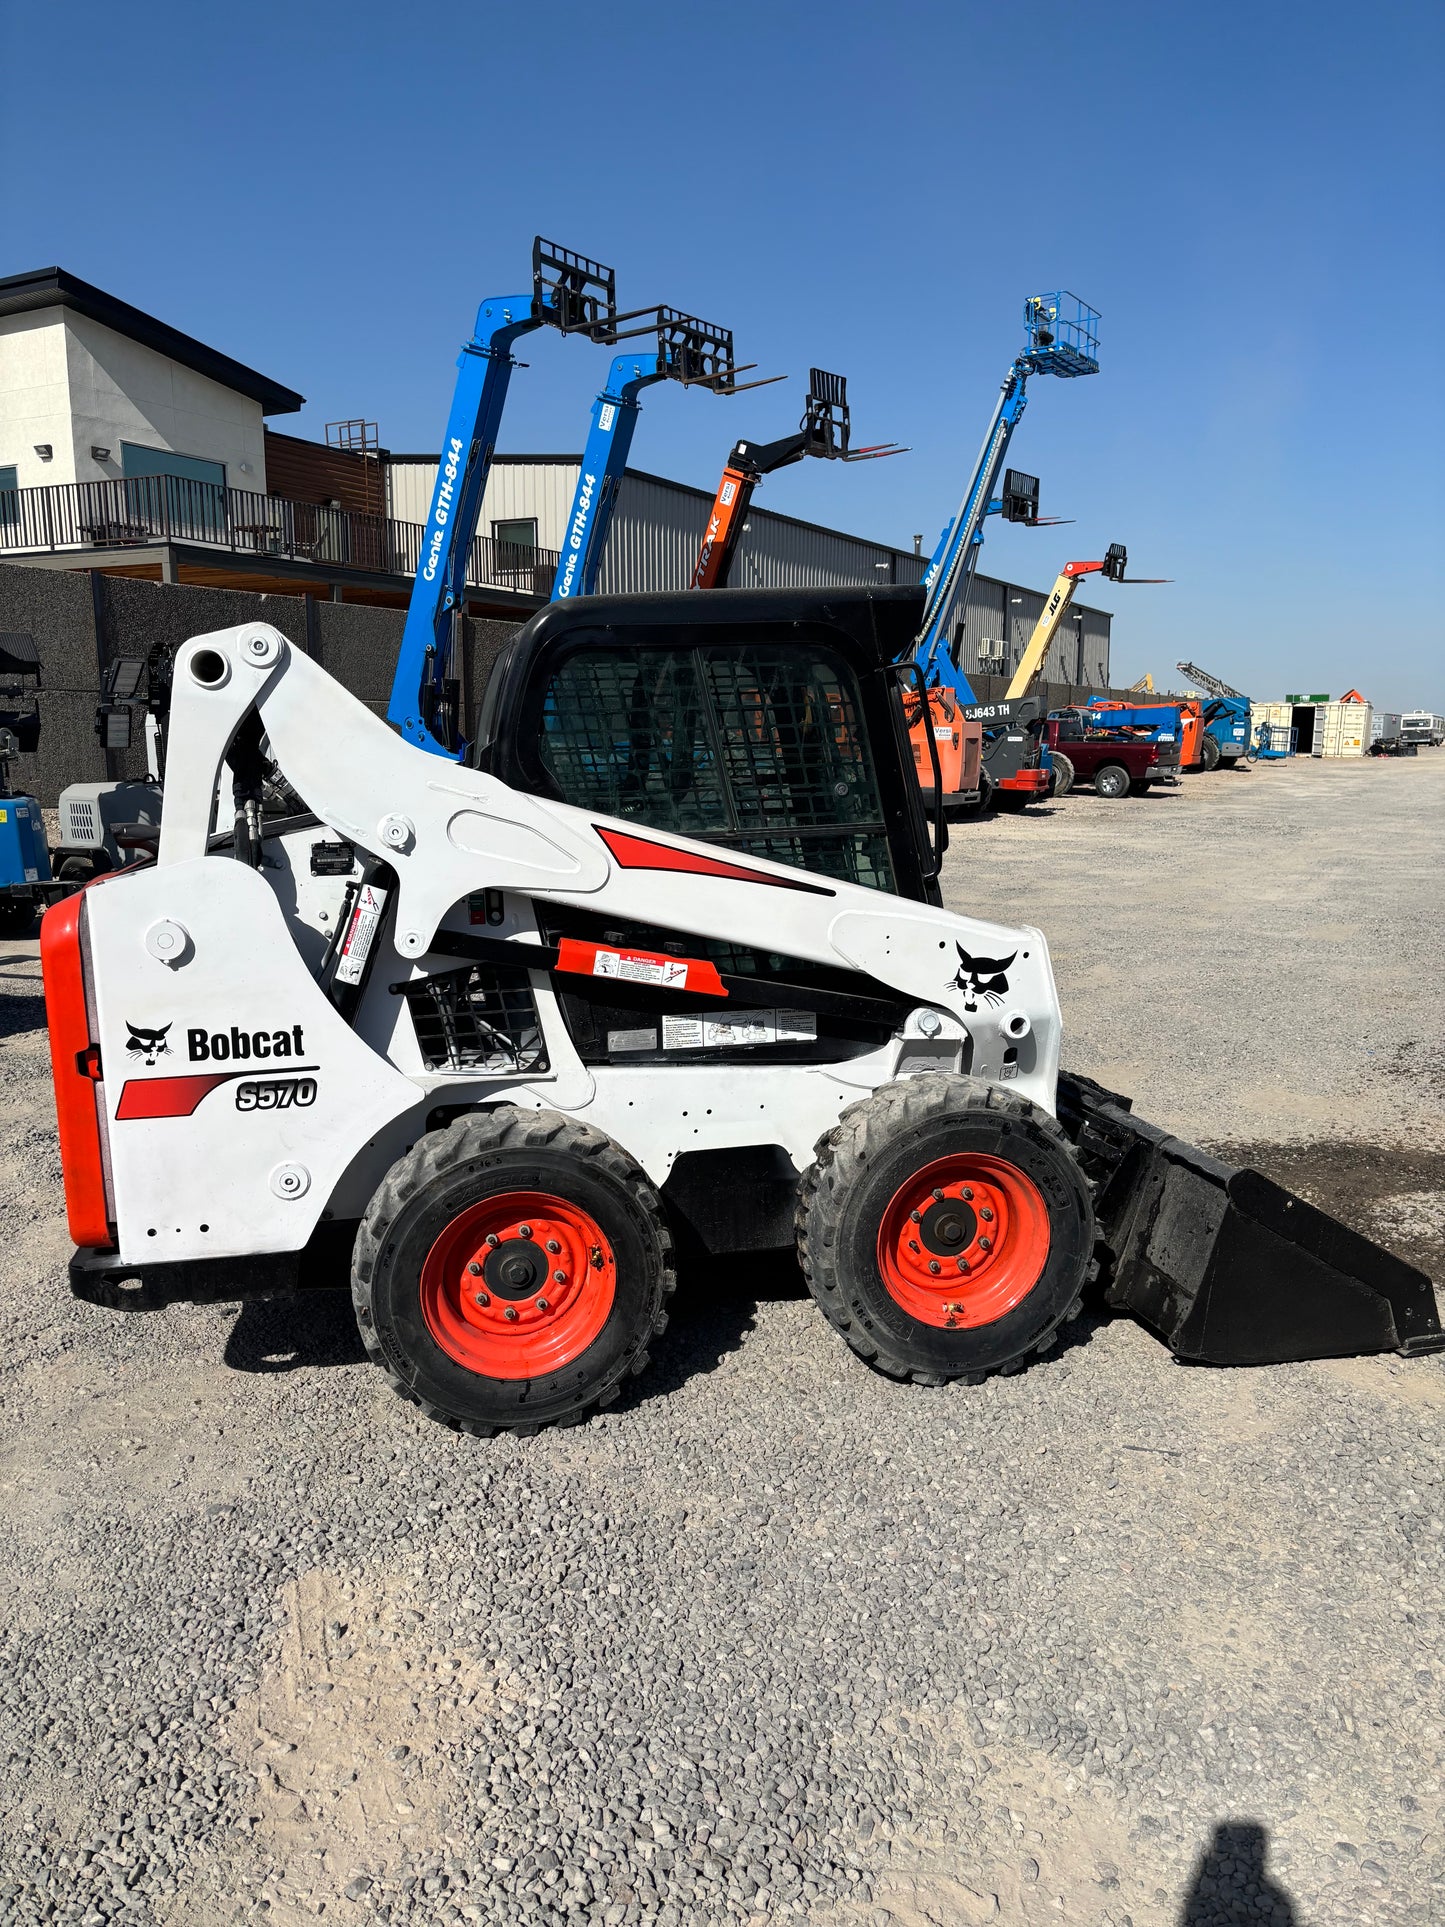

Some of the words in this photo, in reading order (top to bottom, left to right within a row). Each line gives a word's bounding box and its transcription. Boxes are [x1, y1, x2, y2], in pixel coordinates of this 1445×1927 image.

[423, 530, 444, 581] Genie
[435, 437, 463, 525] GTH-844
[558, 553, 577, 597] Genie
[570, 473, 596, 549] GTH-844
[1049, 592, 1061, 616] JLG
[966, 706, 995, 719] SJ643
[998, 704, 1010, 715] TH
[347, 917, 358, 941] DANGER
[633, 956, 657, 965] DANGER
[187, 1025, 304, 1061] Bobcat
[235, 1078, 318, 1112] S570
